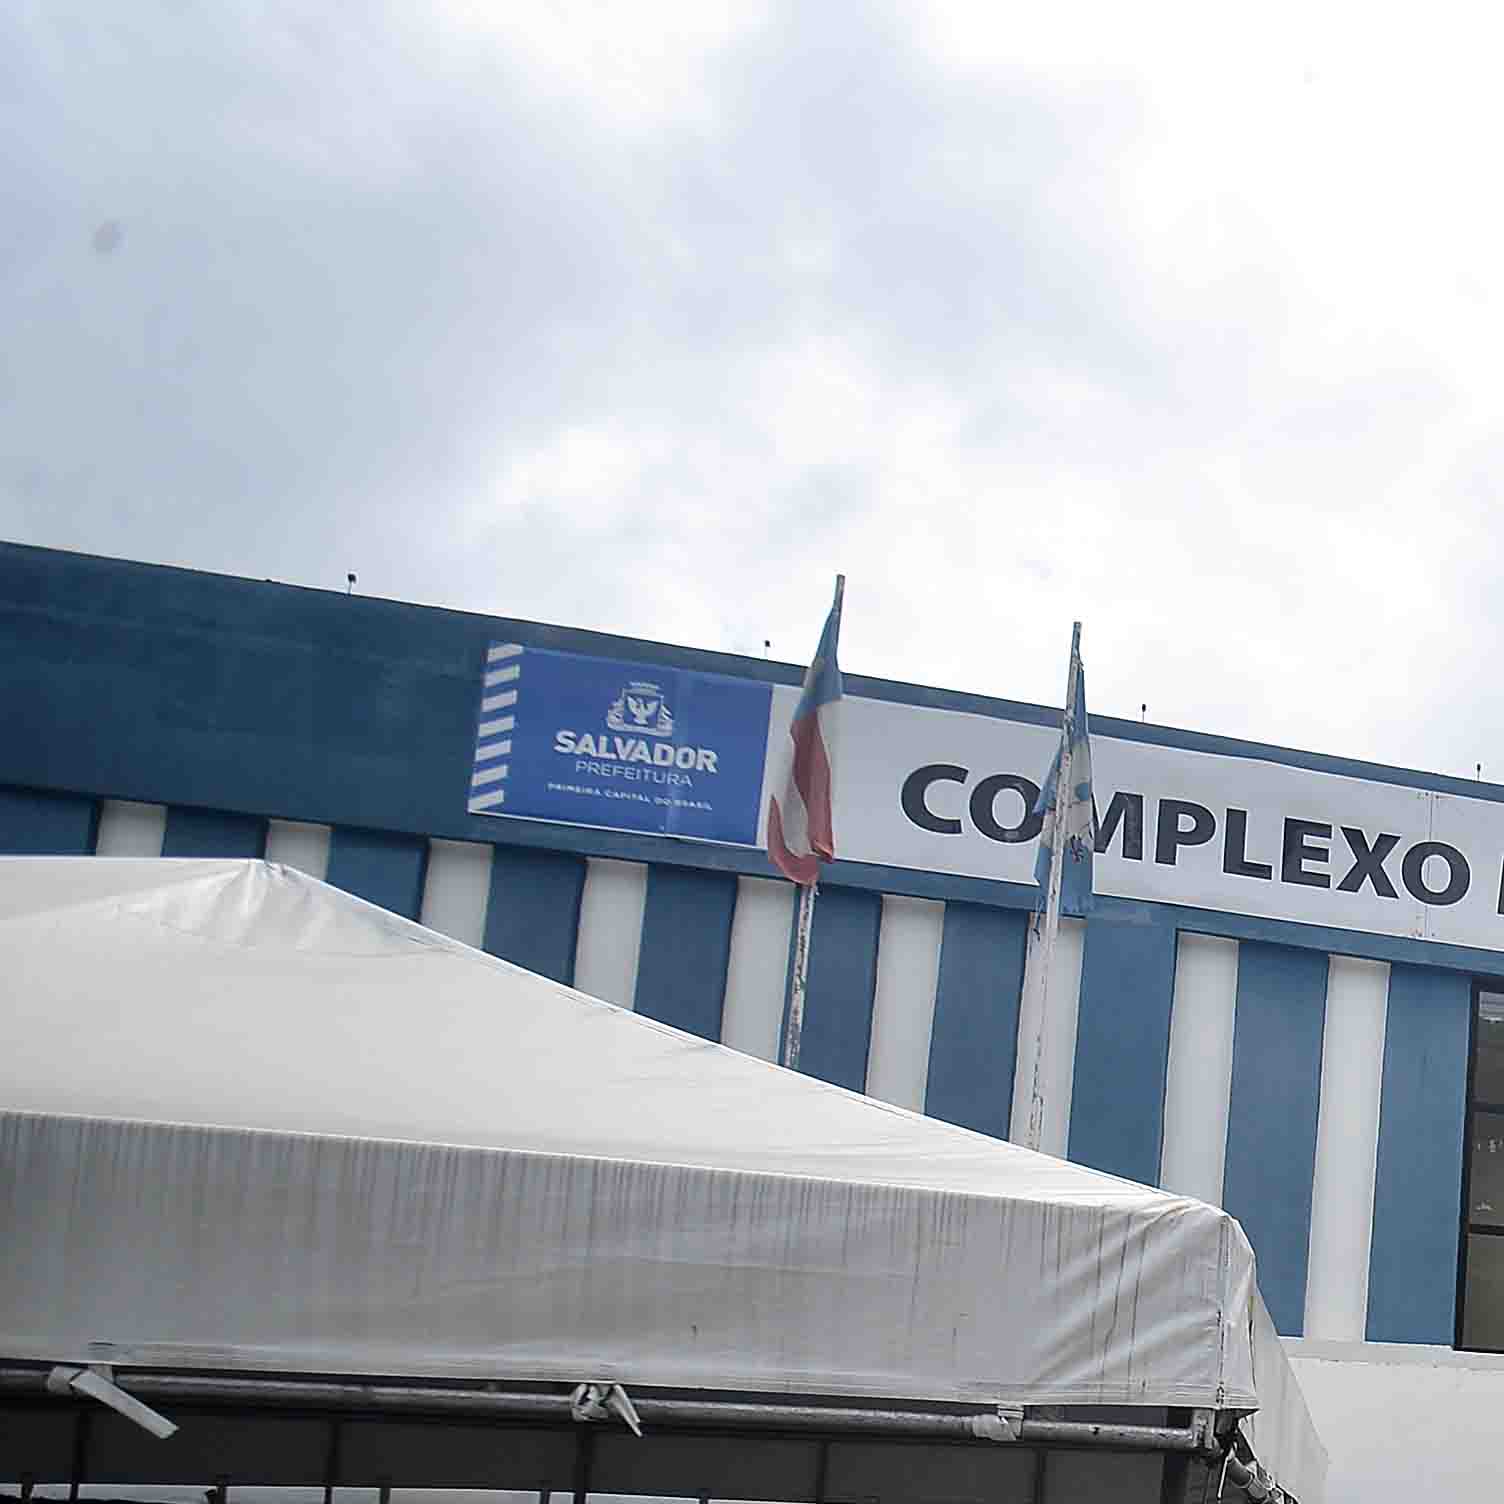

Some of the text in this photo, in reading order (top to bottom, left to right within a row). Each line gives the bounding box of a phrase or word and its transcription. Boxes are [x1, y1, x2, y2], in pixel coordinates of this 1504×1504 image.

[554, 730, 719, 774] SALVADOR
[575, 760, 694, 788] PREFEITURA
[901, 763, 1471, 906] COMPLEXO
